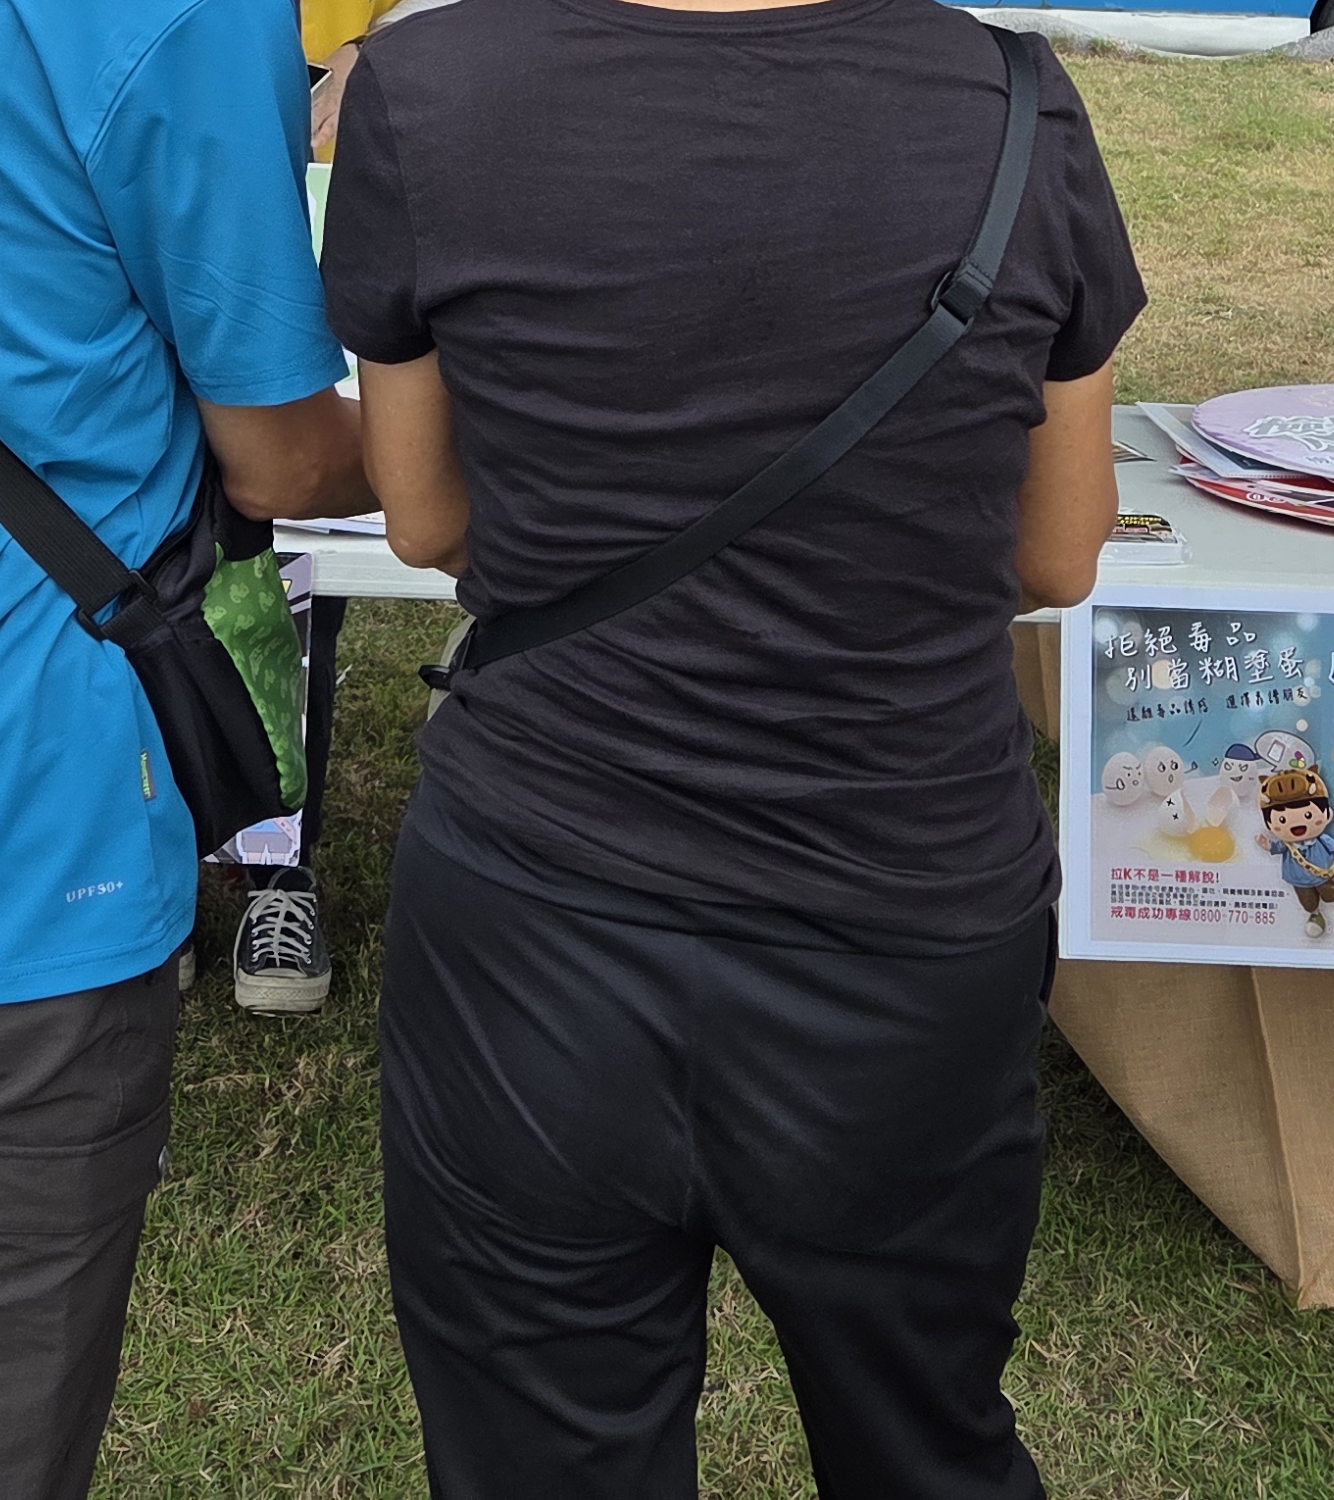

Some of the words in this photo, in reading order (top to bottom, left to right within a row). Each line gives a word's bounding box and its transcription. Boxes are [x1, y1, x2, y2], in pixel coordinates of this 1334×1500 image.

[1104, 621, 1257, 658] 拒絕毒品
[1125, 647, 1304, 691] 別當糊塗蛋
